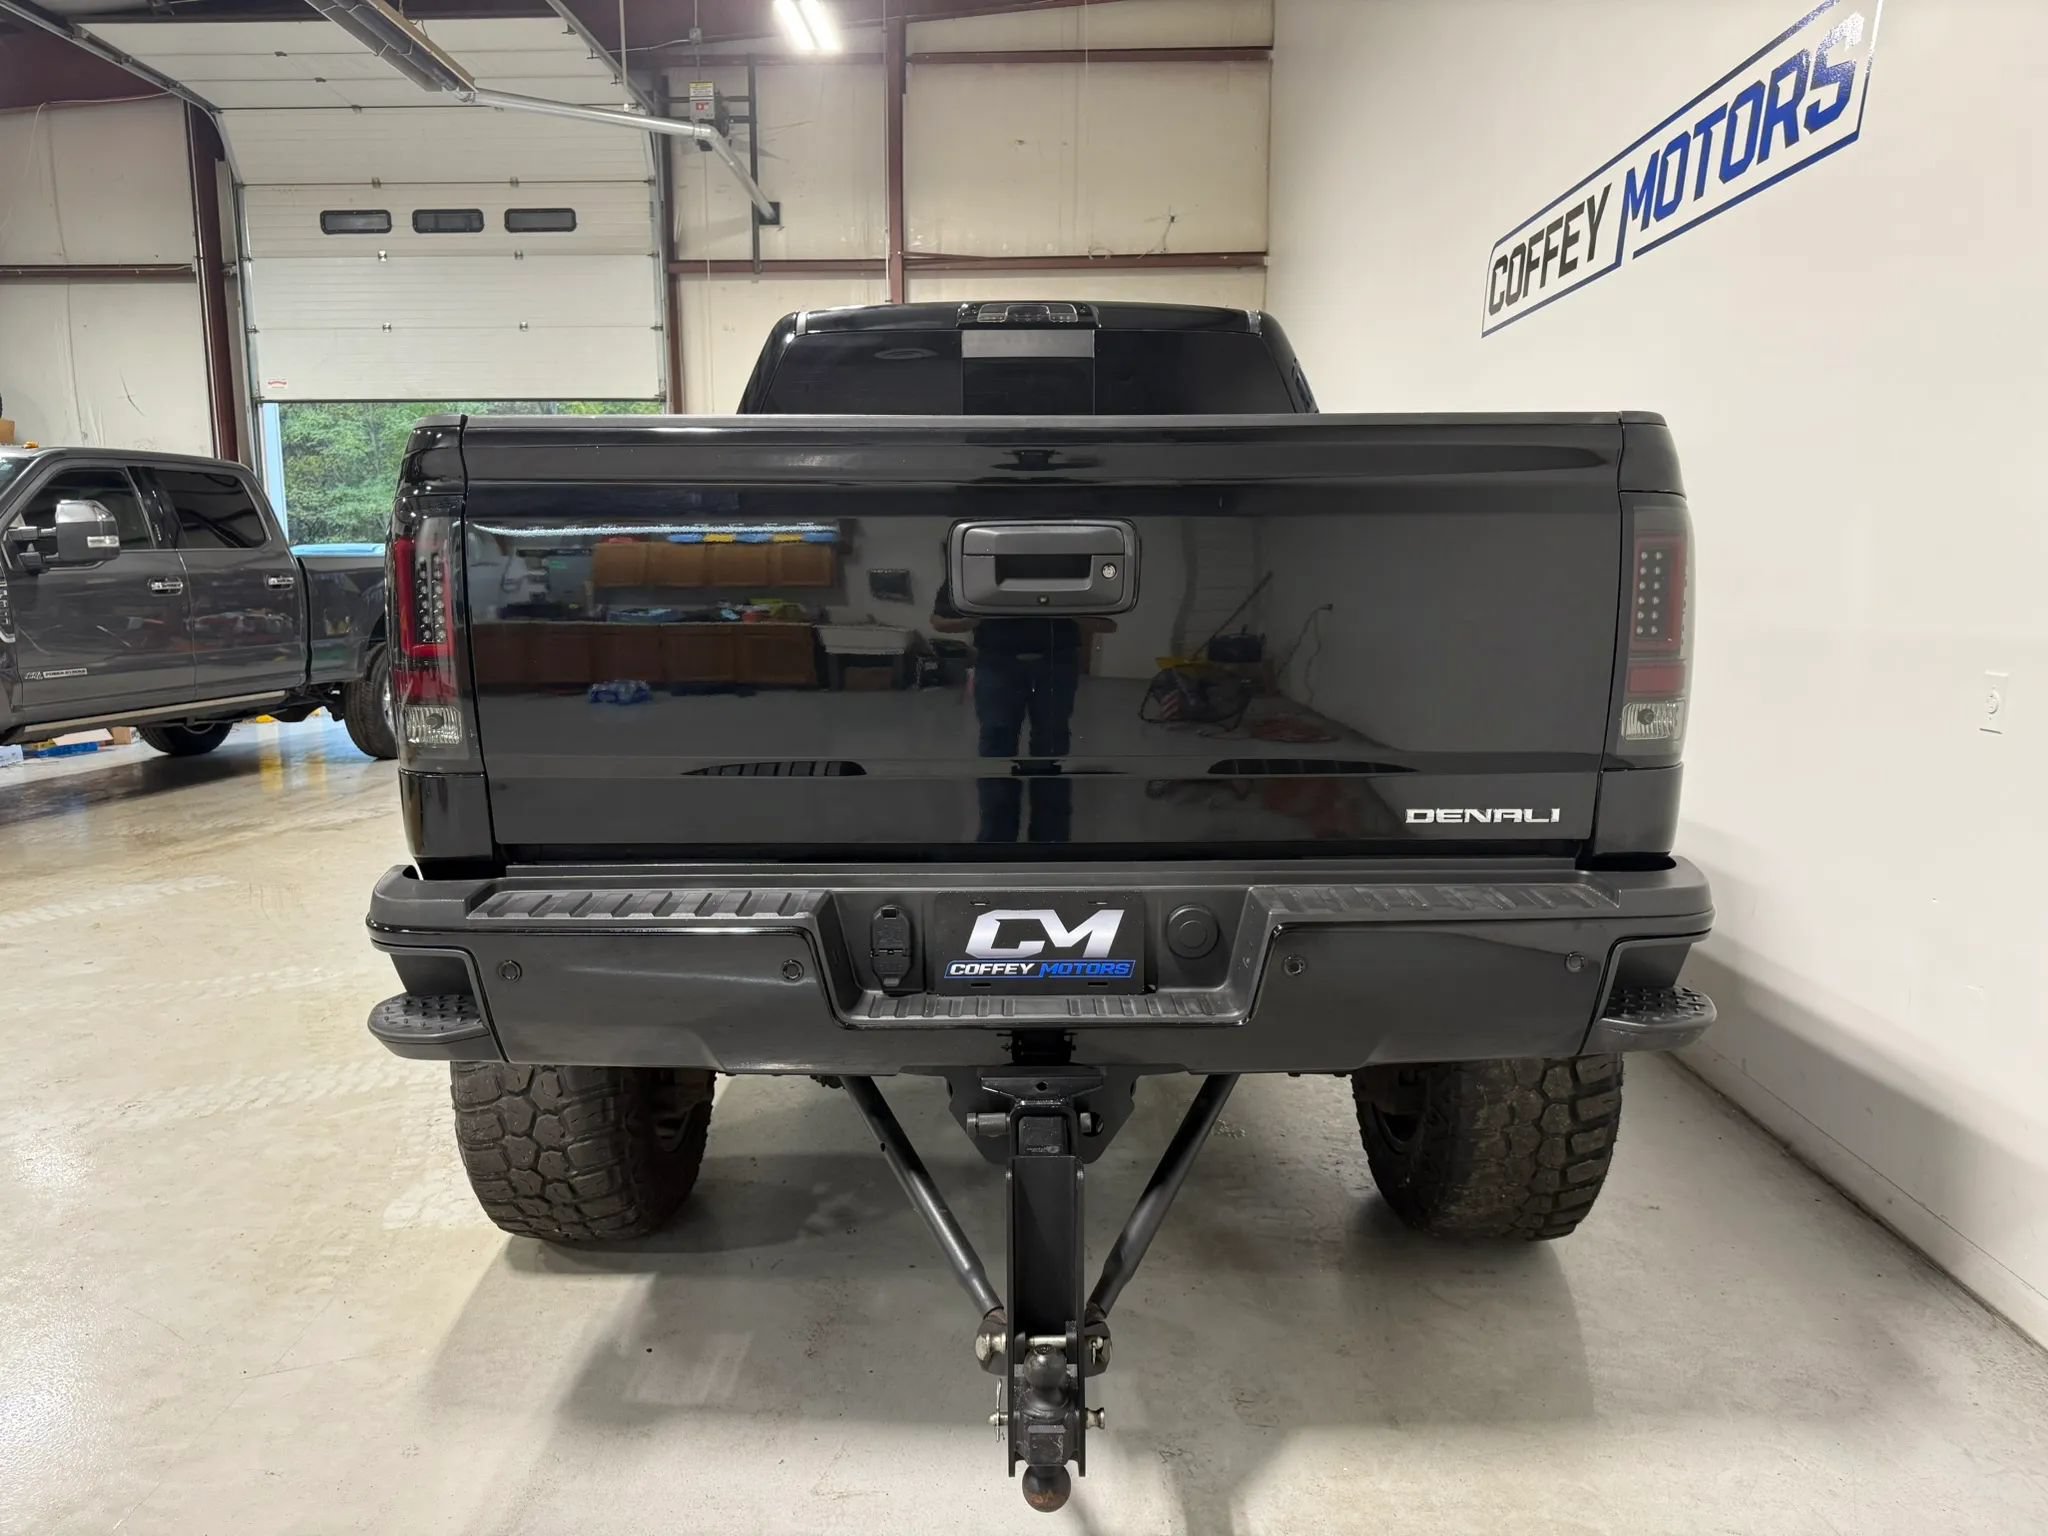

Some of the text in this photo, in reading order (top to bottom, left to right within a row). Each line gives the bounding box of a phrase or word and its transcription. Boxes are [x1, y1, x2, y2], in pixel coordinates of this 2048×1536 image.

[1489, 12, 1864, 316] COFFEY MOTORS
[1405, 808, 1560, 823] DENALI
[965, 909, 1125, 959] CM
[950, 963, 1131, 976] COFFEY MOTORS
